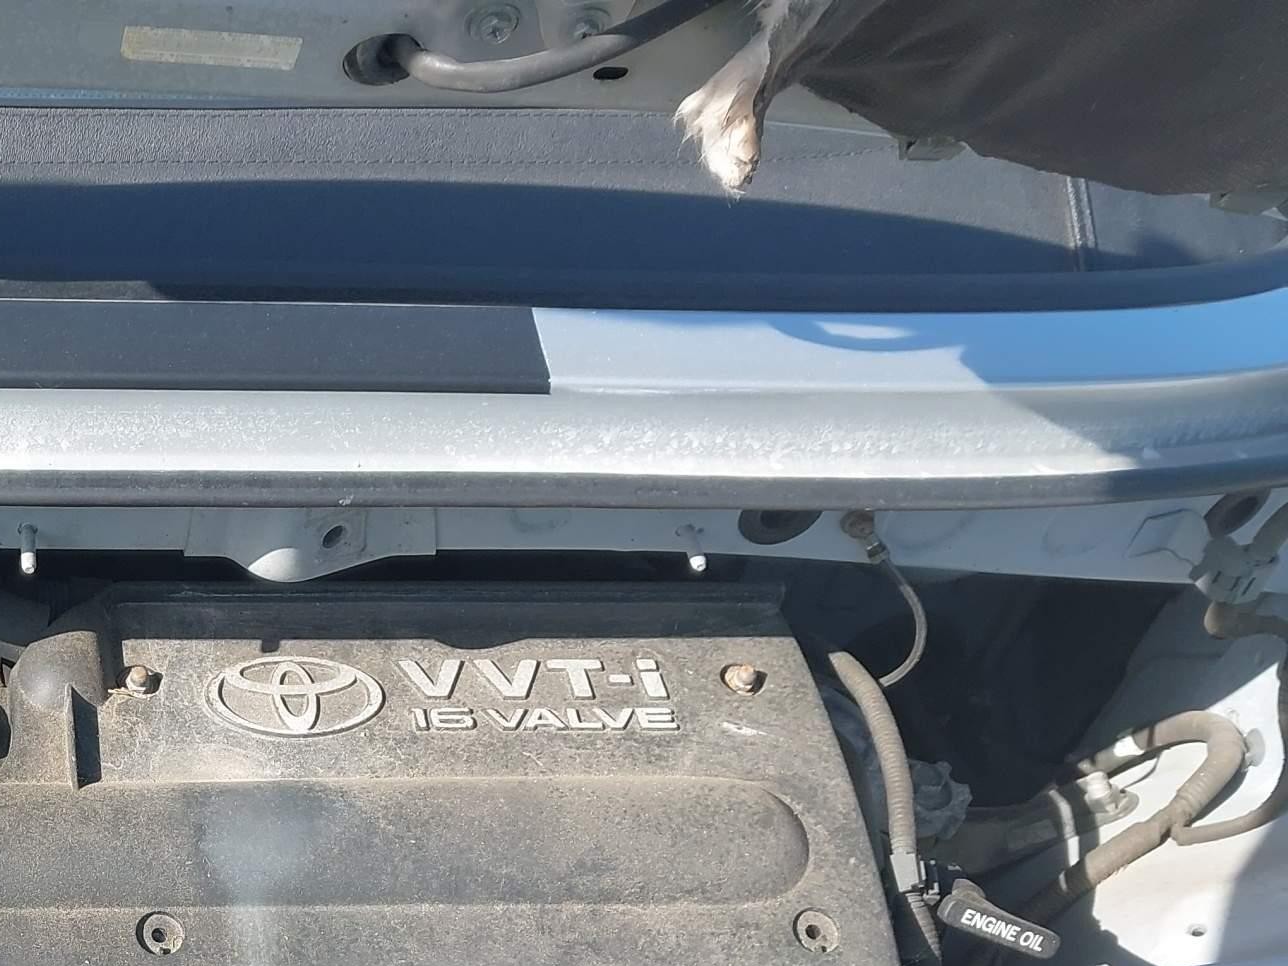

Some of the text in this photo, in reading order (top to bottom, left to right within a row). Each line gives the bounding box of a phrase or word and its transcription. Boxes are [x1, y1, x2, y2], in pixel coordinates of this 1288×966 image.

[395, 657, 671, 700] VVT-i
[409, 706, 681, 732] 16 VALVE
[960, 909, 1045, 952] ENGINE OIL
